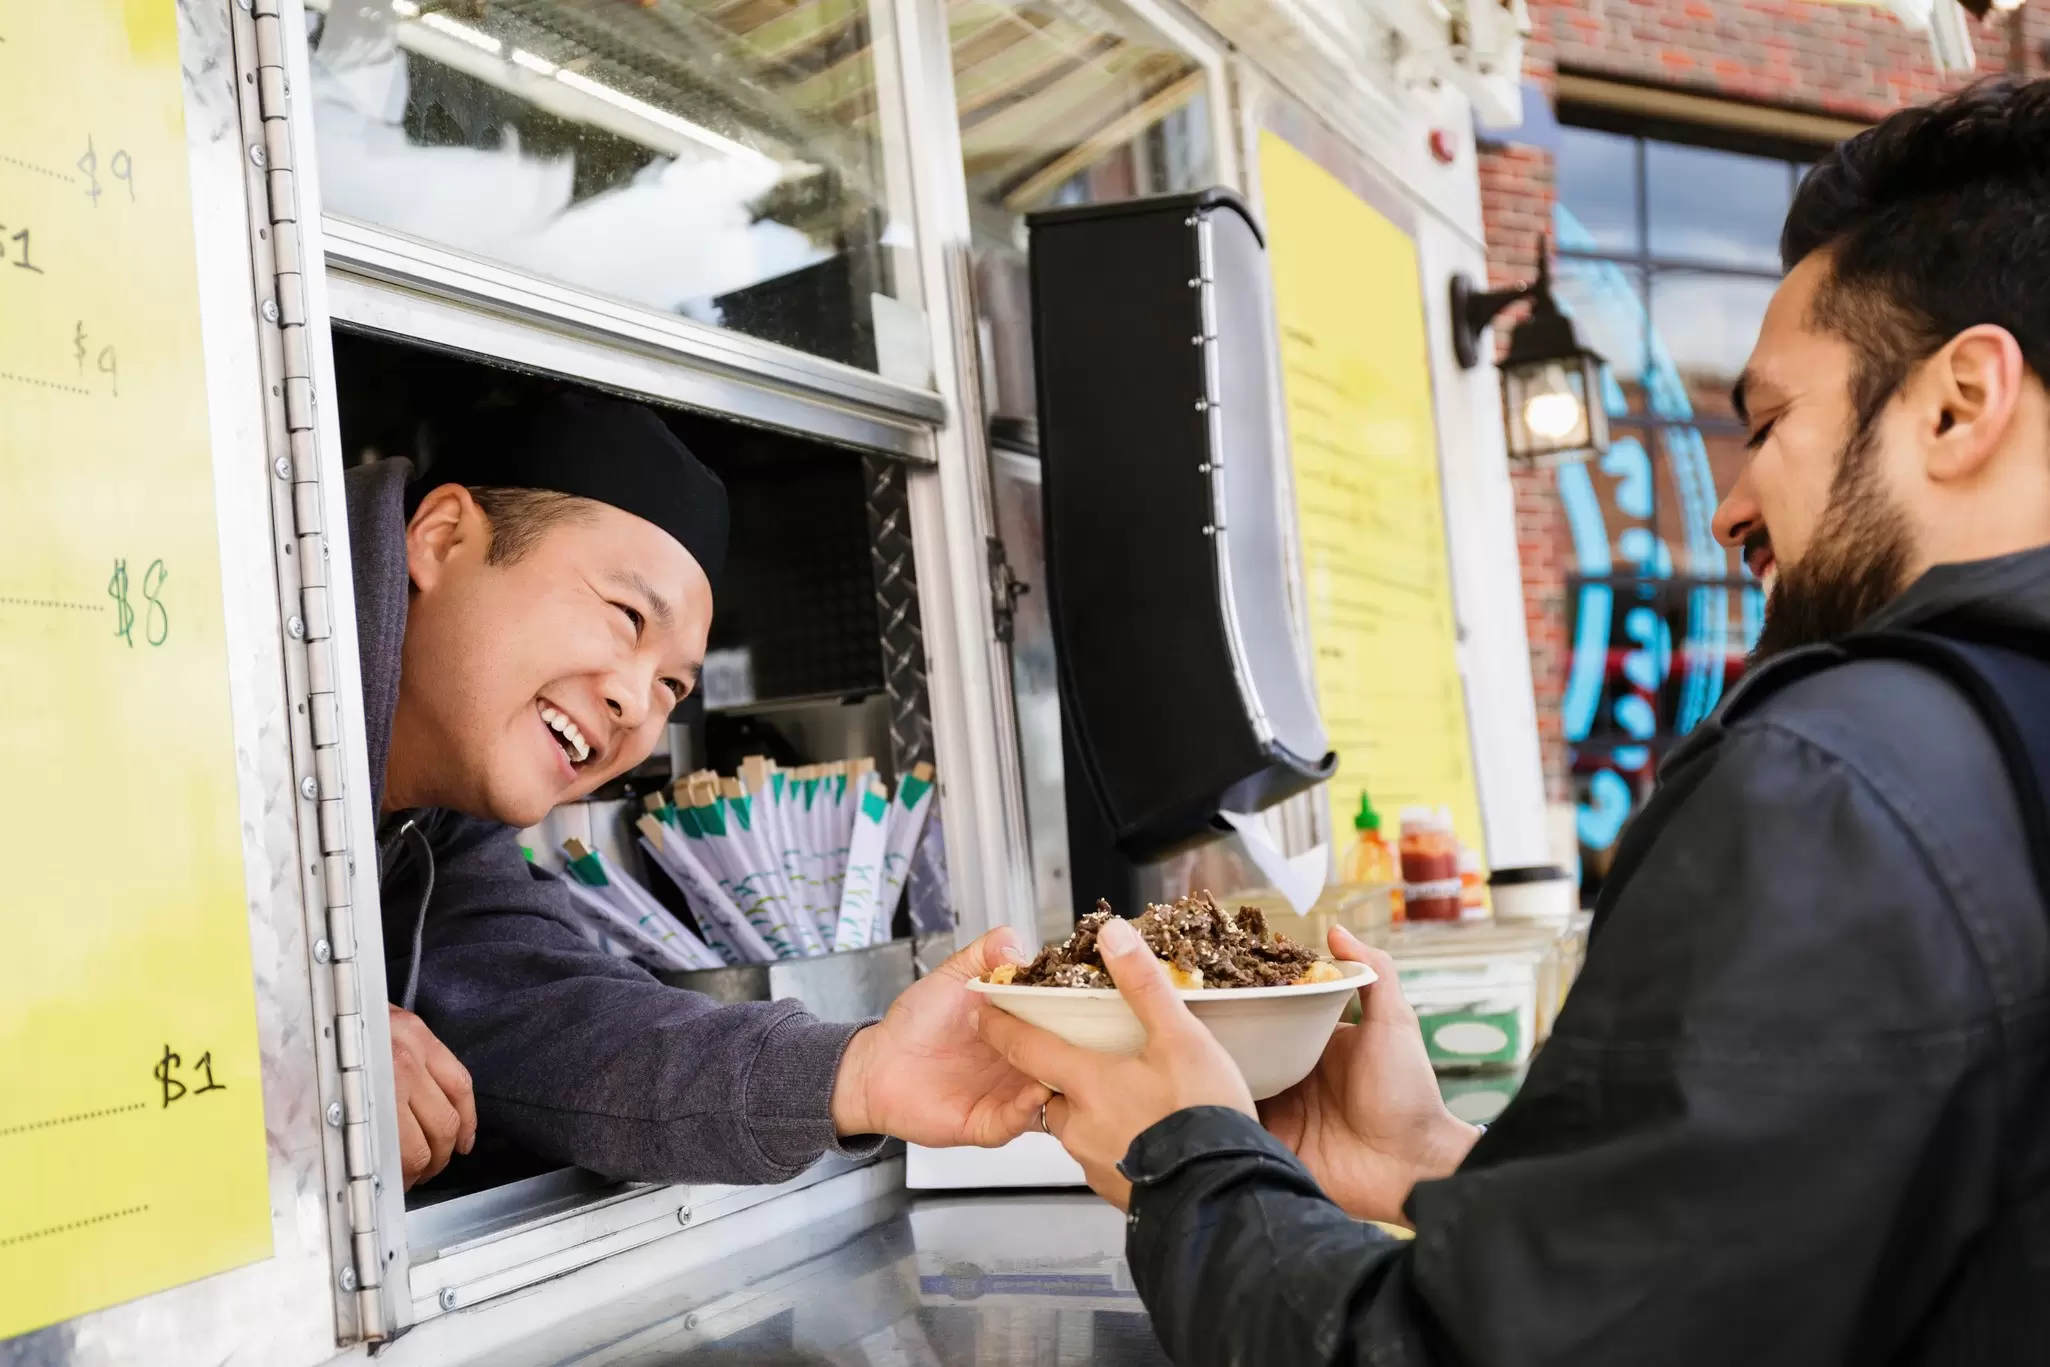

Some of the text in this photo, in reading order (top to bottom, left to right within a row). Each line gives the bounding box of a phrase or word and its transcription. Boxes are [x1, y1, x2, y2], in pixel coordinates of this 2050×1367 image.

[77, 132, 135, 208] $9
[73, 320, 118, 398] $9
[108, 557, 168, 648] $8
[153, 1044, 226, 1109] $1
